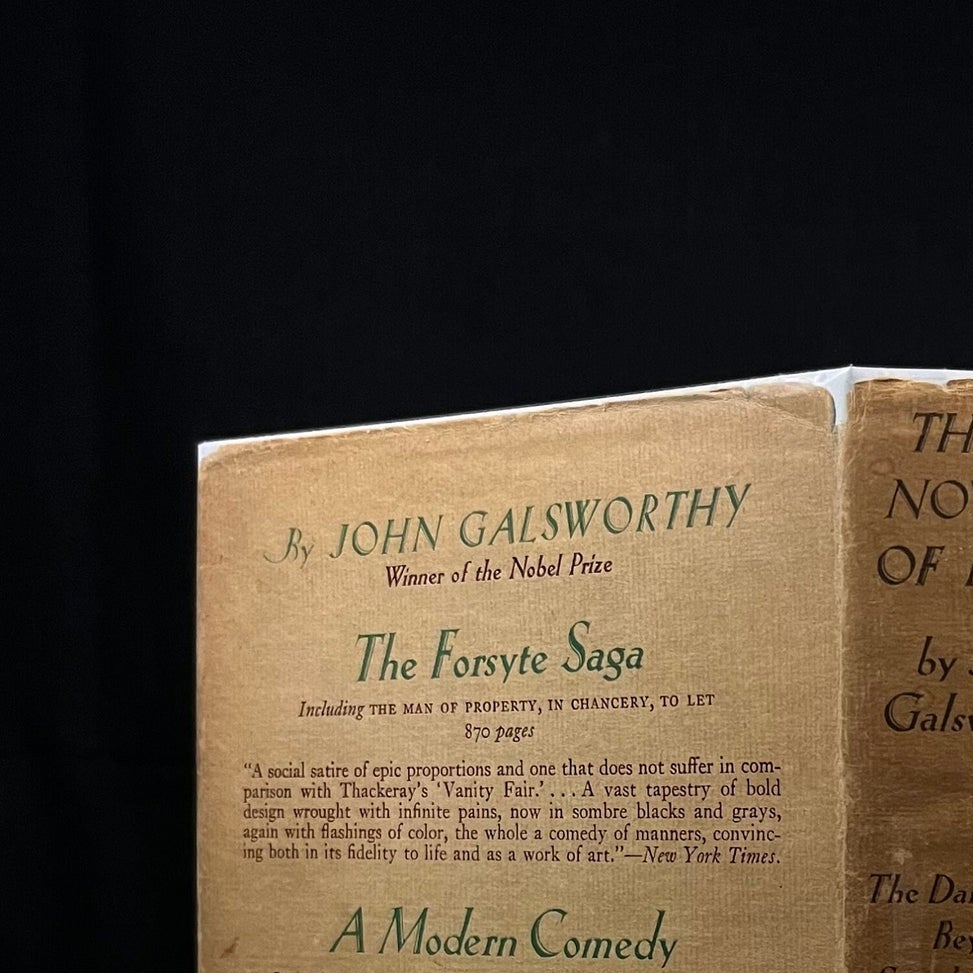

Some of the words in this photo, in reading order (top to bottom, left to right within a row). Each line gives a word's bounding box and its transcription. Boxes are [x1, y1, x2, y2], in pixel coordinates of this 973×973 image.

[263, 528, 314, 569] By
[329, 515, 443, 558] JOHN
[460, 483, 751, 547] GALSWORTHY
[386, 565, 444, 587] Winner
[452, 561, 472, 582] of
[476, 559, 501, 581] the
[509, 554, 563, 579] Nobel
[569, 553, 612, 575] Prize
[877, 545, 945, 586] OF
[356, 632, 417, 681] The
[431, 629, 547, 683] Forsyte
[561, 621, 643, 681] Saga
[918, 636, 957, 682] by
[298, 700, 365, 720] Including
[369, 704, 396, 715] THE
[403, 703, 433, 714] MAN
[441, 702, 458, 713] OF
[466, 700, 542, 715] PROPERTY,
[548, 699, 563, 710] IN
[571, 696, 654, 712] CHANCERY,
[660, 695, 678, 707] TO
[688, 694, 715, 706] LET
[465, 723, 490, 742] 870
[494, 726, 534, 742] pages
[268, 762, 305, 778] social
[311, 761, 348, 778] satire
[354, 761, 369, 777] of
[373, 761, 401, 783] epic
[407, 760, 491, 784] proportions
[497, 760, 524, 776] and
[530, 765, 556, 775] one
[562, 758, 594, 776] that
[600, 758, 632, 775] does
[639, 761, 664, 774] not
[670, 756, 713, 774] suffer
[720, 758, 738, 774] in
[742, 762, 781, 773] com-
[868, 873, 919, 904] The
[329, 907, 364, 953] A
[378, 907, 517, 956] Modern
[531, 909, 678, 968] Comedy
